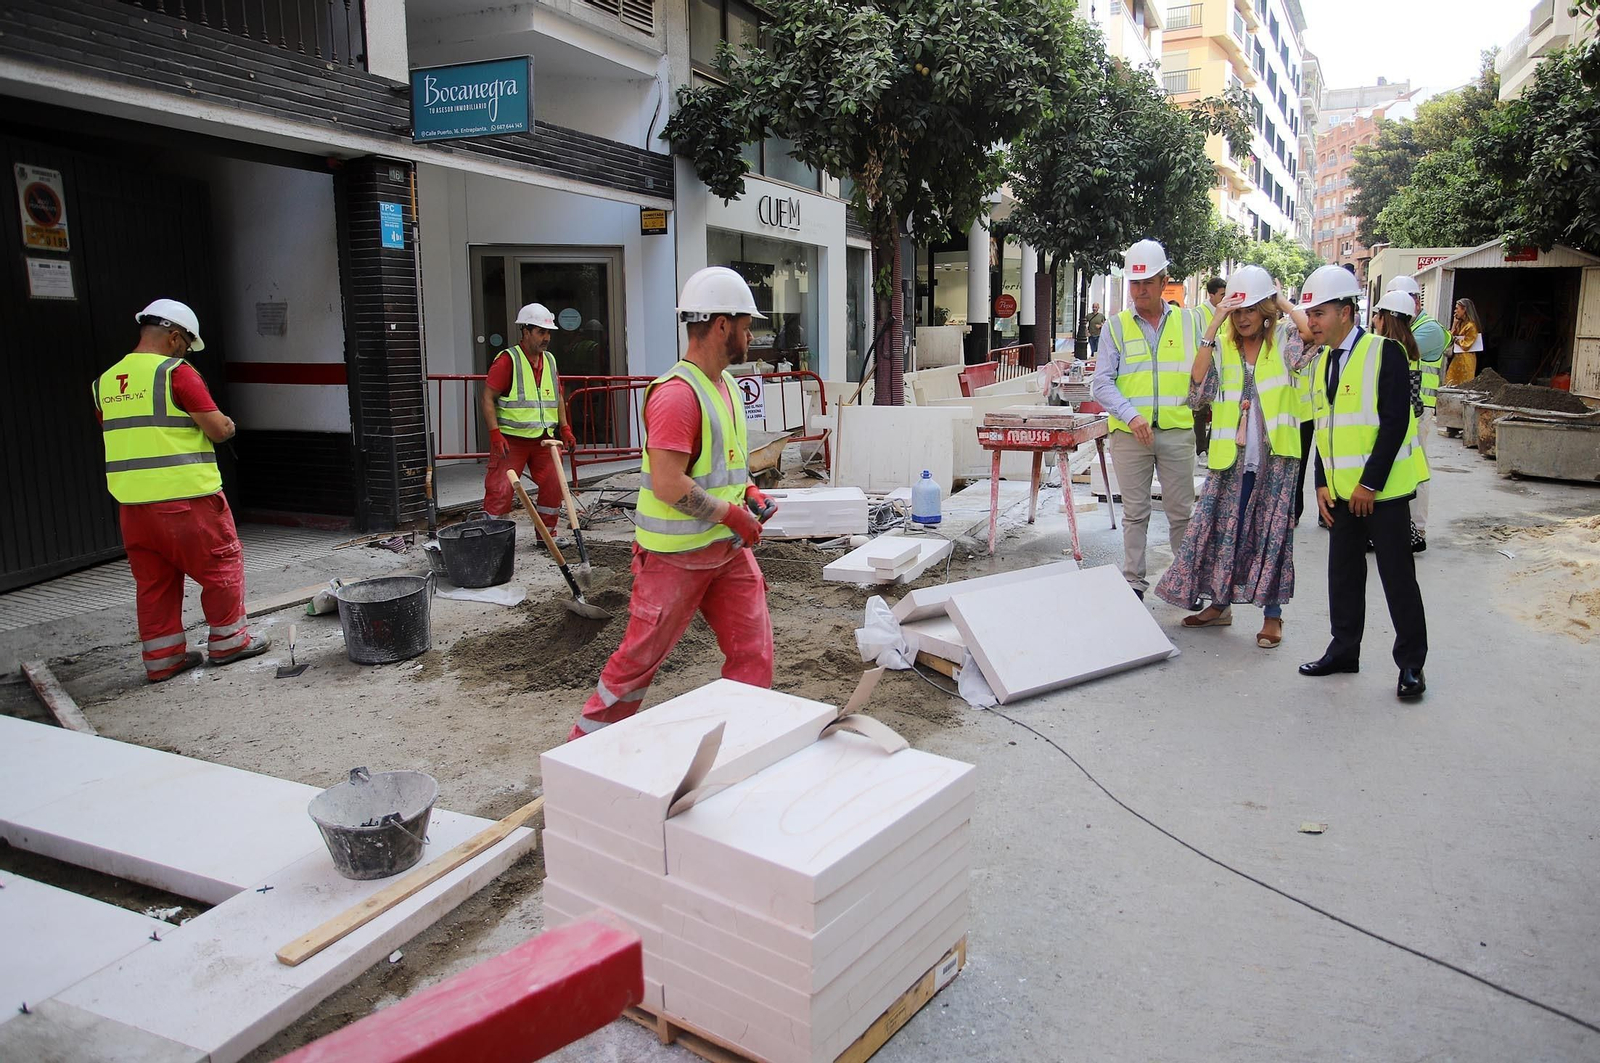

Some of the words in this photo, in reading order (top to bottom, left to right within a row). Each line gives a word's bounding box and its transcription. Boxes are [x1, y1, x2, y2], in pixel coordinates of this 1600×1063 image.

[424, 74, 518, 122] Bocanegra
[436, 106, 454, 114] ASESOR
[454, 102, 487, 112] INMOBILIARIO
[380, 203, 395, 213] TPC
[758, 195, 801, 231] CUEM
[1007, 430, 1051, 442] MAUSA
